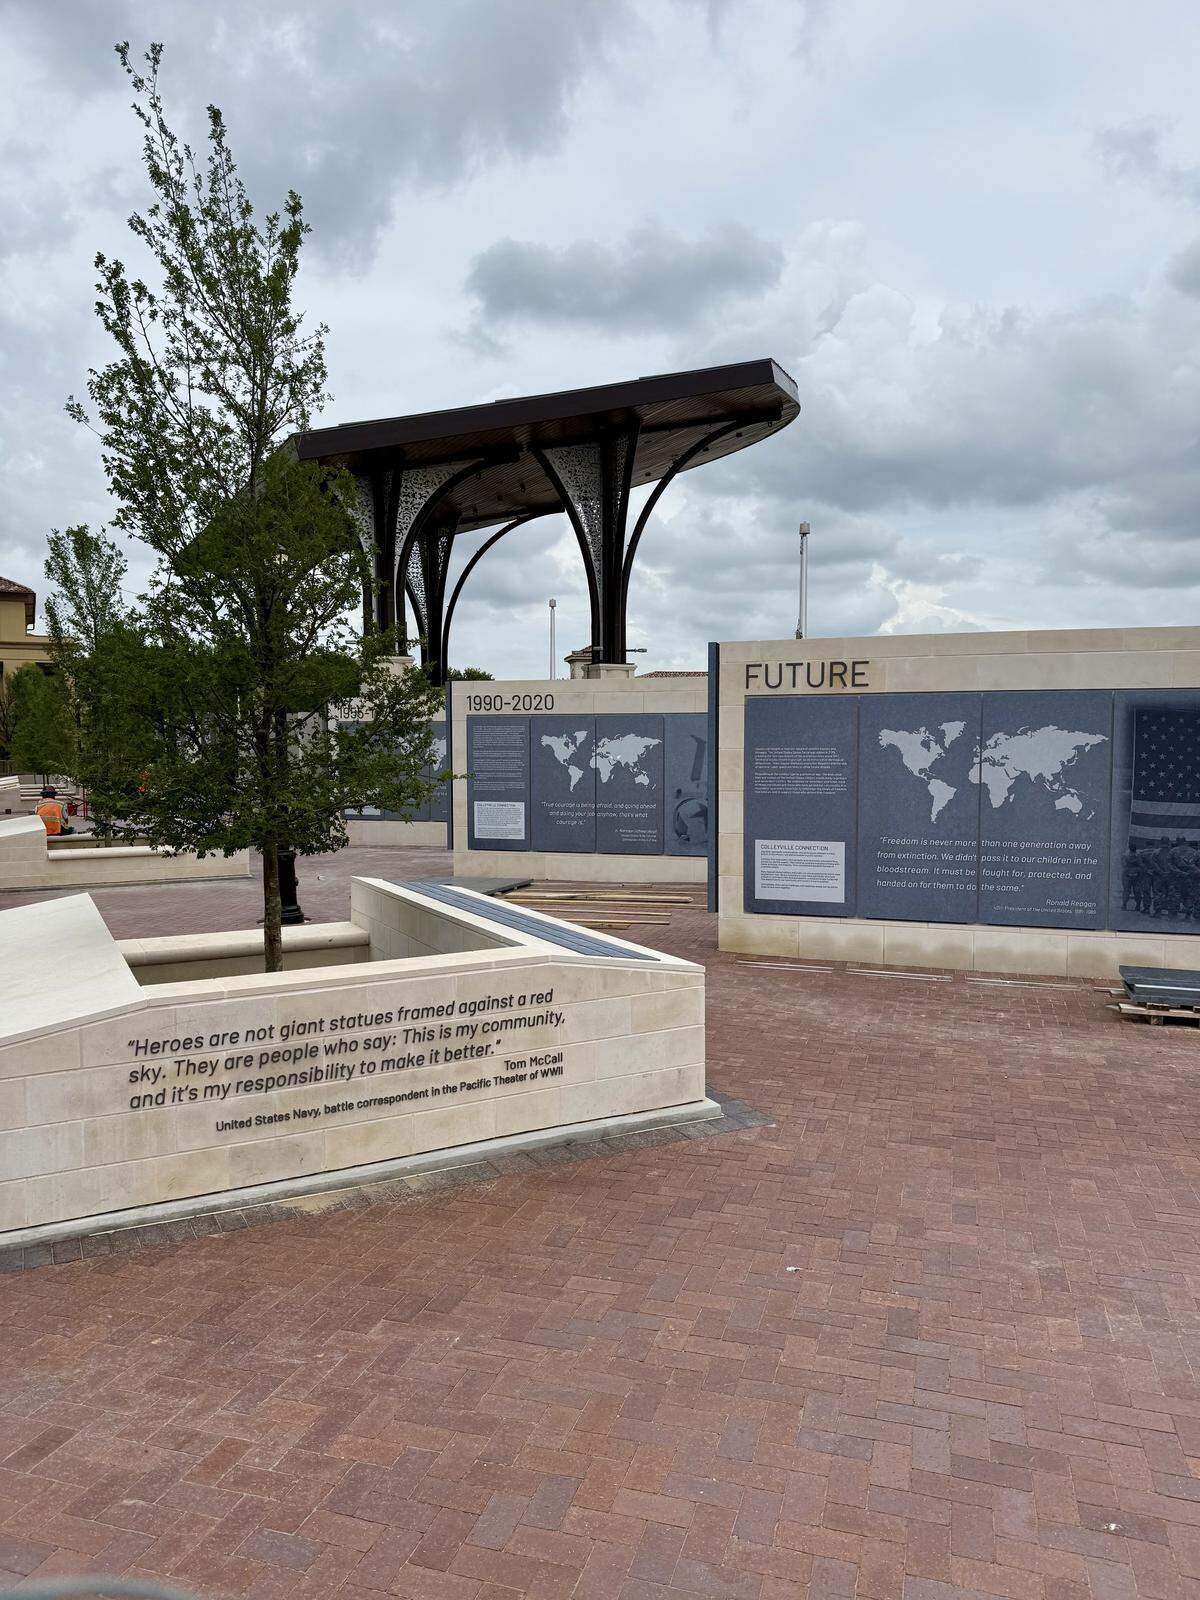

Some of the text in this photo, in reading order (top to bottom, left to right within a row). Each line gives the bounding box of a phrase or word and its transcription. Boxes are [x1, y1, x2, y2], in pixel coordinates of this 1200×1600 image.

[745, 660, 870, 690] FUTURE
[466, 694, 554, 711] 1990-2020
[1020, 840, 1066, 850] generation
[1069, 843, 1092, 851] away
[898, 852, 938, 860] extinction.
[1037, 856, 1072, 864] children
[876, 865, 930, 874] bloodstream.
[982, 868, 1010, 878] fought
[1075, 872, 1092, 880] and
[877, 880, 906, 888] handed
[934, 882, 954, 890] them
[1070, 900, 1096, 908] Reagan
[209, 1031, 240, 1048] are
[244, 1024, 275, 1042] not
[280, 1018, 325, 1042] giant
[330, 1010, 393, 1032] statues
[398, 1001, 455, 1022] framed
[458, 994, 514, 1016] against
[518, 997, 526, 1006] a
[530, 988, 554, 1004] red
[129, 1010, 566, 1085] sky. They are people who say: This is my community,
[504, 1052, 564, 1071] Tom McCall
[130, 1088, 166, 1109] and
[172, 1084, 198, 1102] it's
[204, 1082, 231, 1100] my
[236, 1062, 356, 1094] responsibility
[360, 1059, 376, 1075] to
[380, 1052, 425, 1072] make
[429, 1048, 440, 1064] it
[216, 1066, 564, 1132] United States Navy, battle correspondent in the Pacific Theater of WWII
